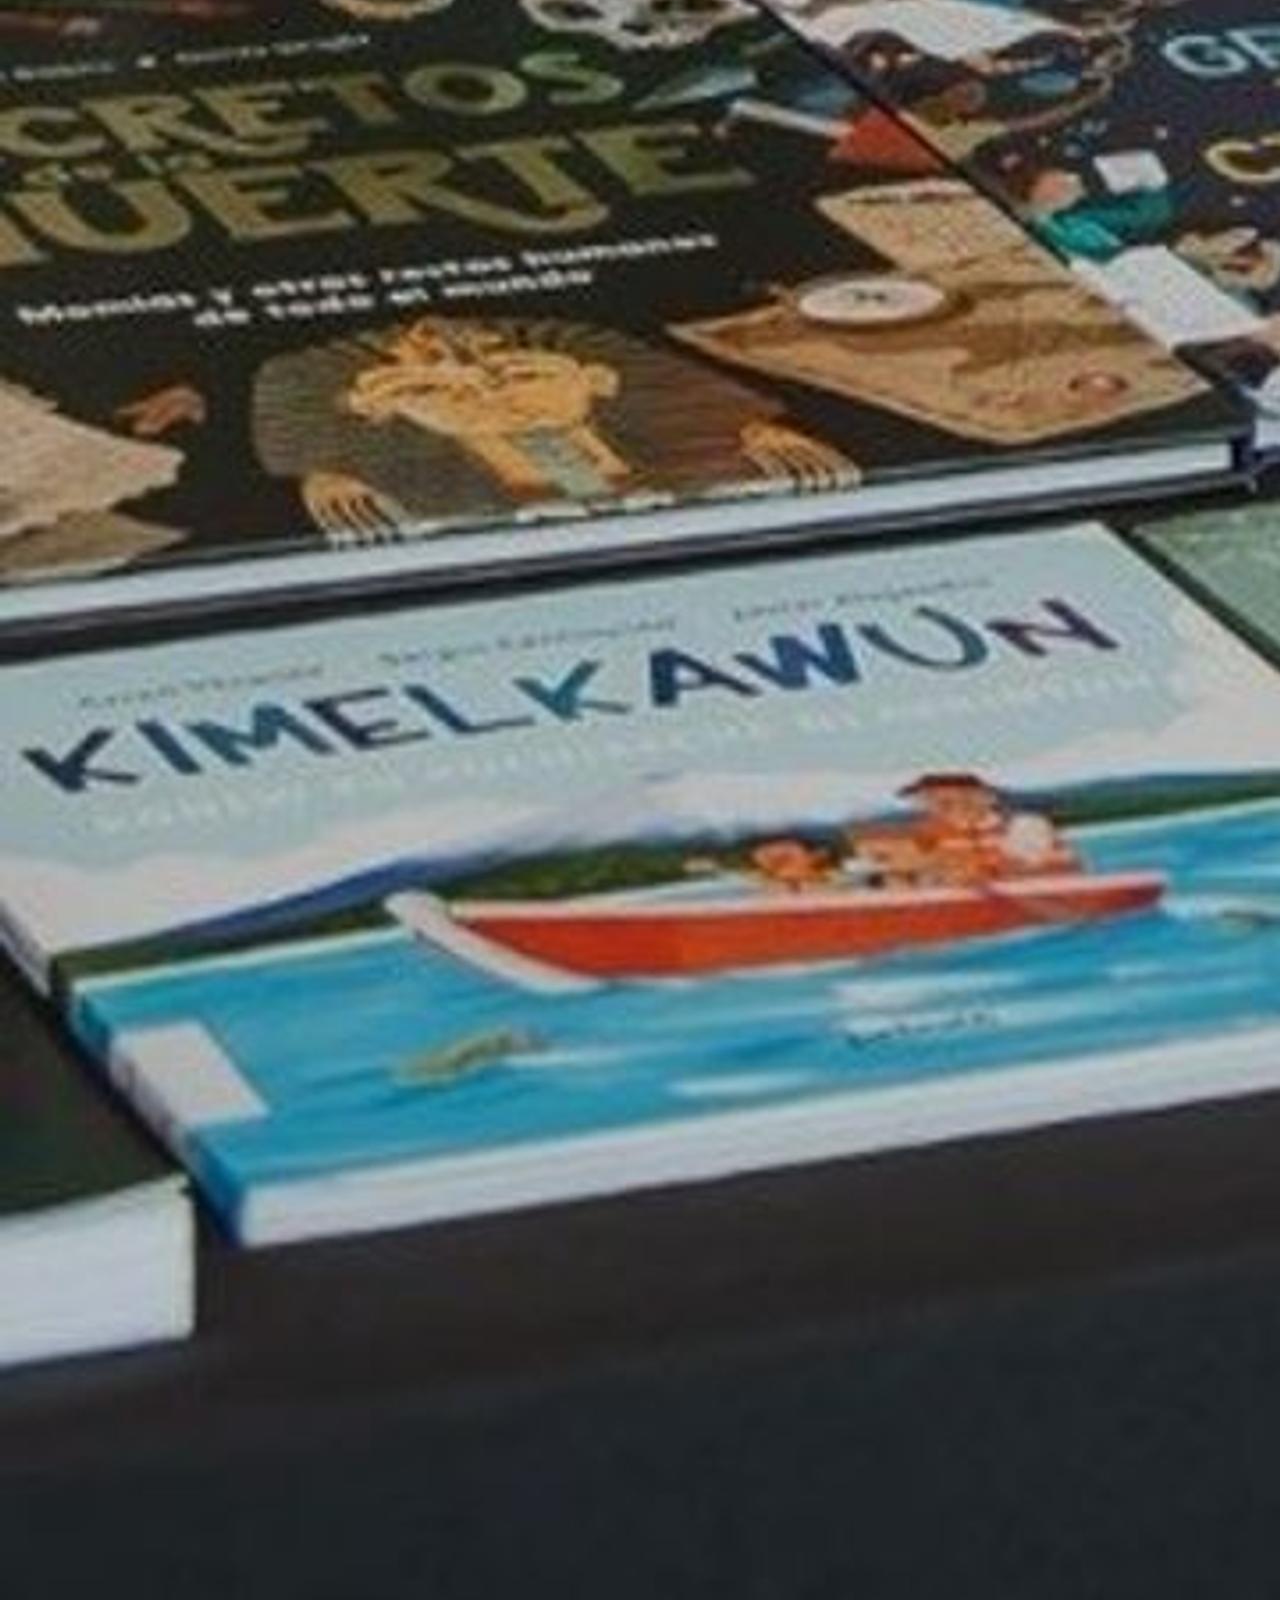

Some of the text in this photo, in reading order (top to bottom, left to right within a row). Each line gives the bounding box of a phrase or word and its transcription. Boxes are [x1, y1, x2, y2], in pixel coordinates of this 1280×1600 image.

[253, 272, 369, 298] otros
[378, 255, 513, 284] restos
[194, 306, 250, 328] de
[266, 294, 374, 319] todo
